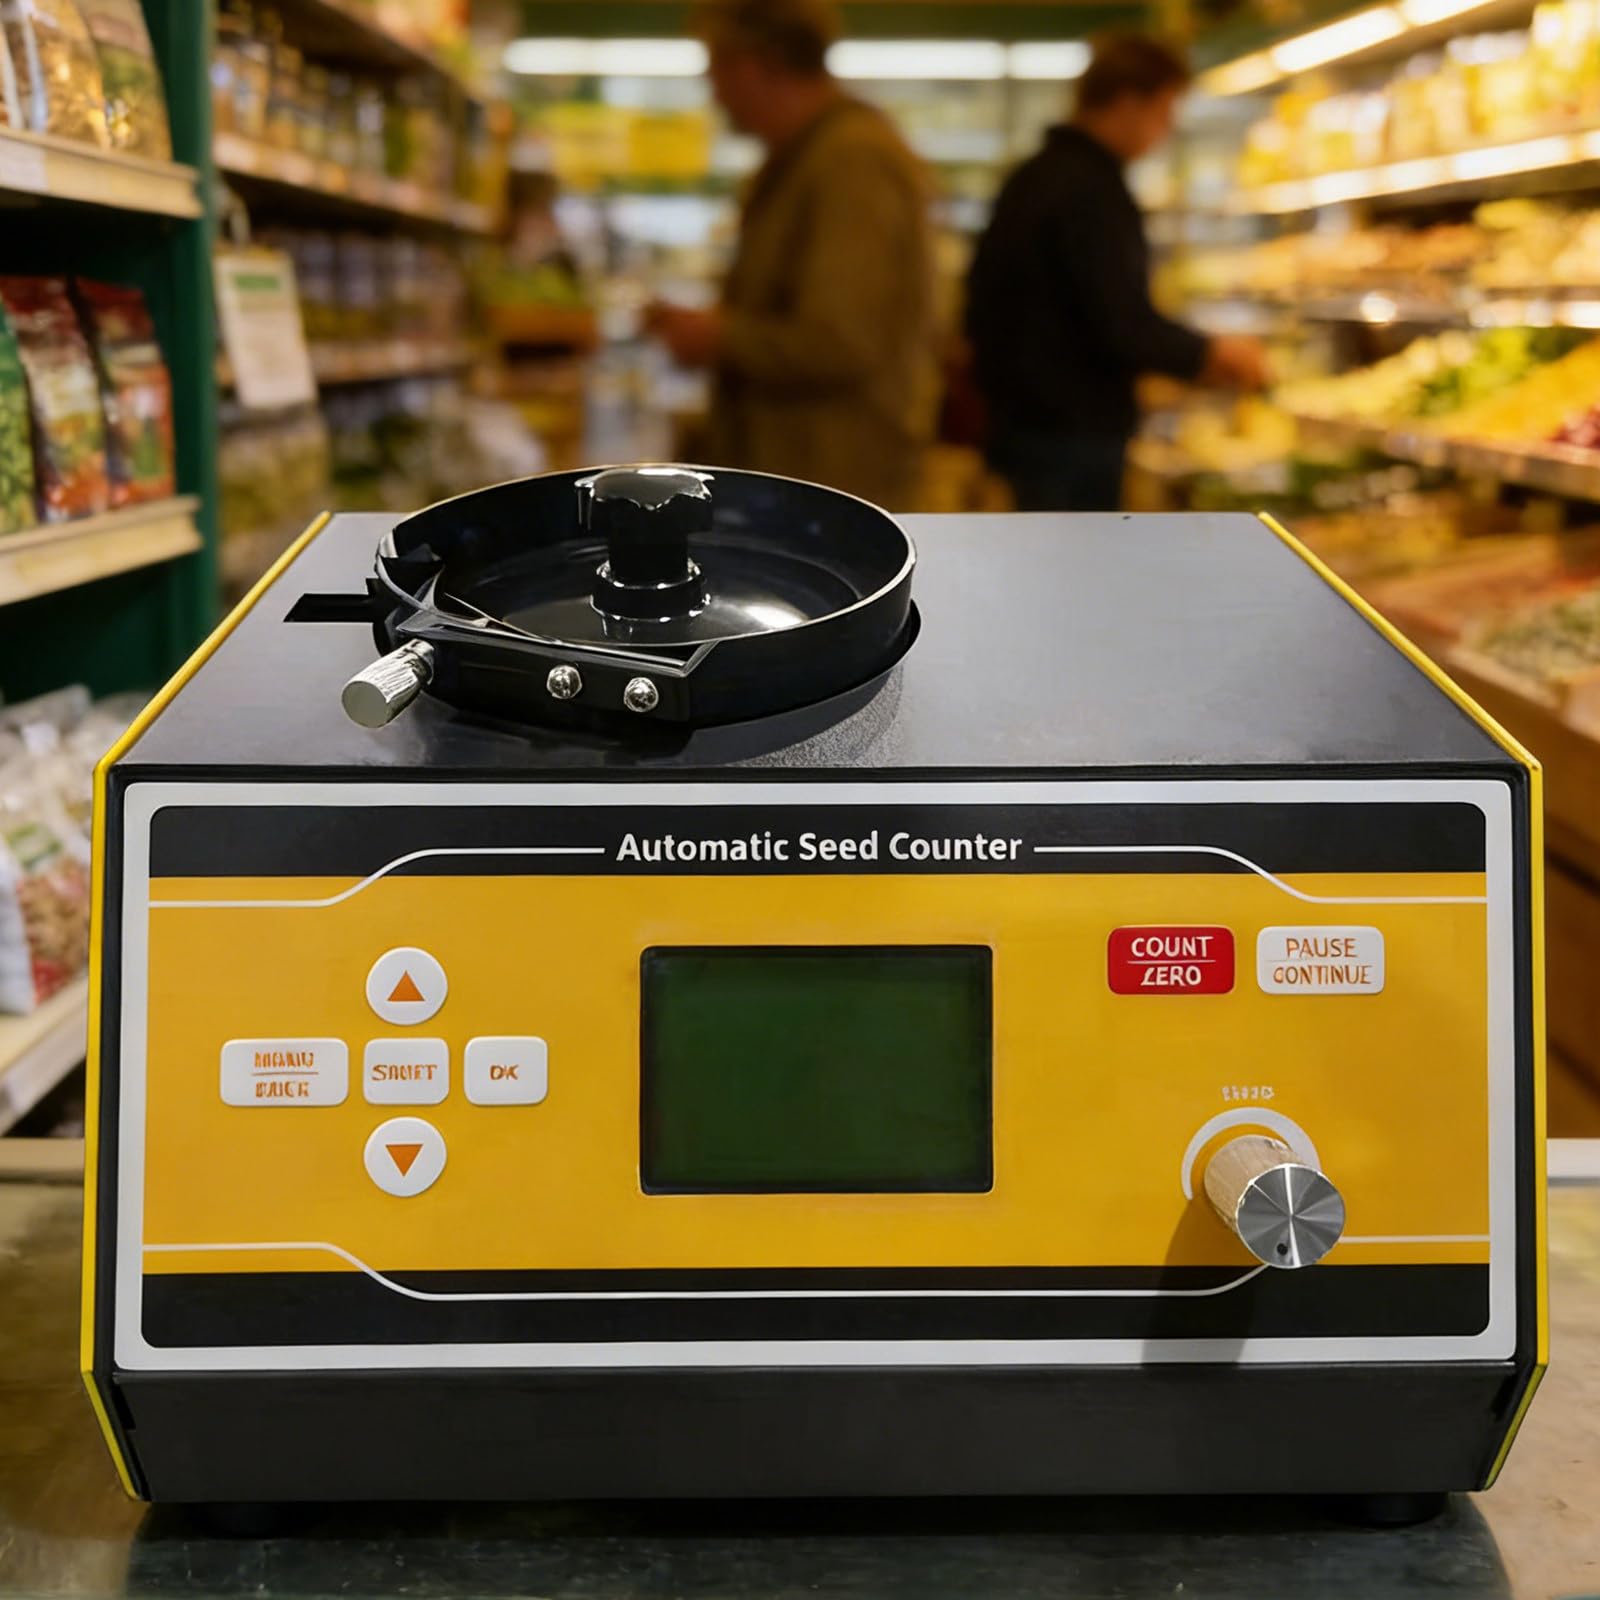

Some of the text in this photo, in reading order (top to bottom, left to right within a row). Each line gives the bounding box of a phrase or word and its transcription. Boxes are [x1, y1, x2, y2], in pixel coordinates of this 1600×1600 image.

[616, 830, 1022, 861] Automatic Seed Counter
[1131, 936, 1213, 957] COUNT
[1286, 937, 1357, 958] PAUSE
[1273, 965, 1372, 985] CONTINUE
